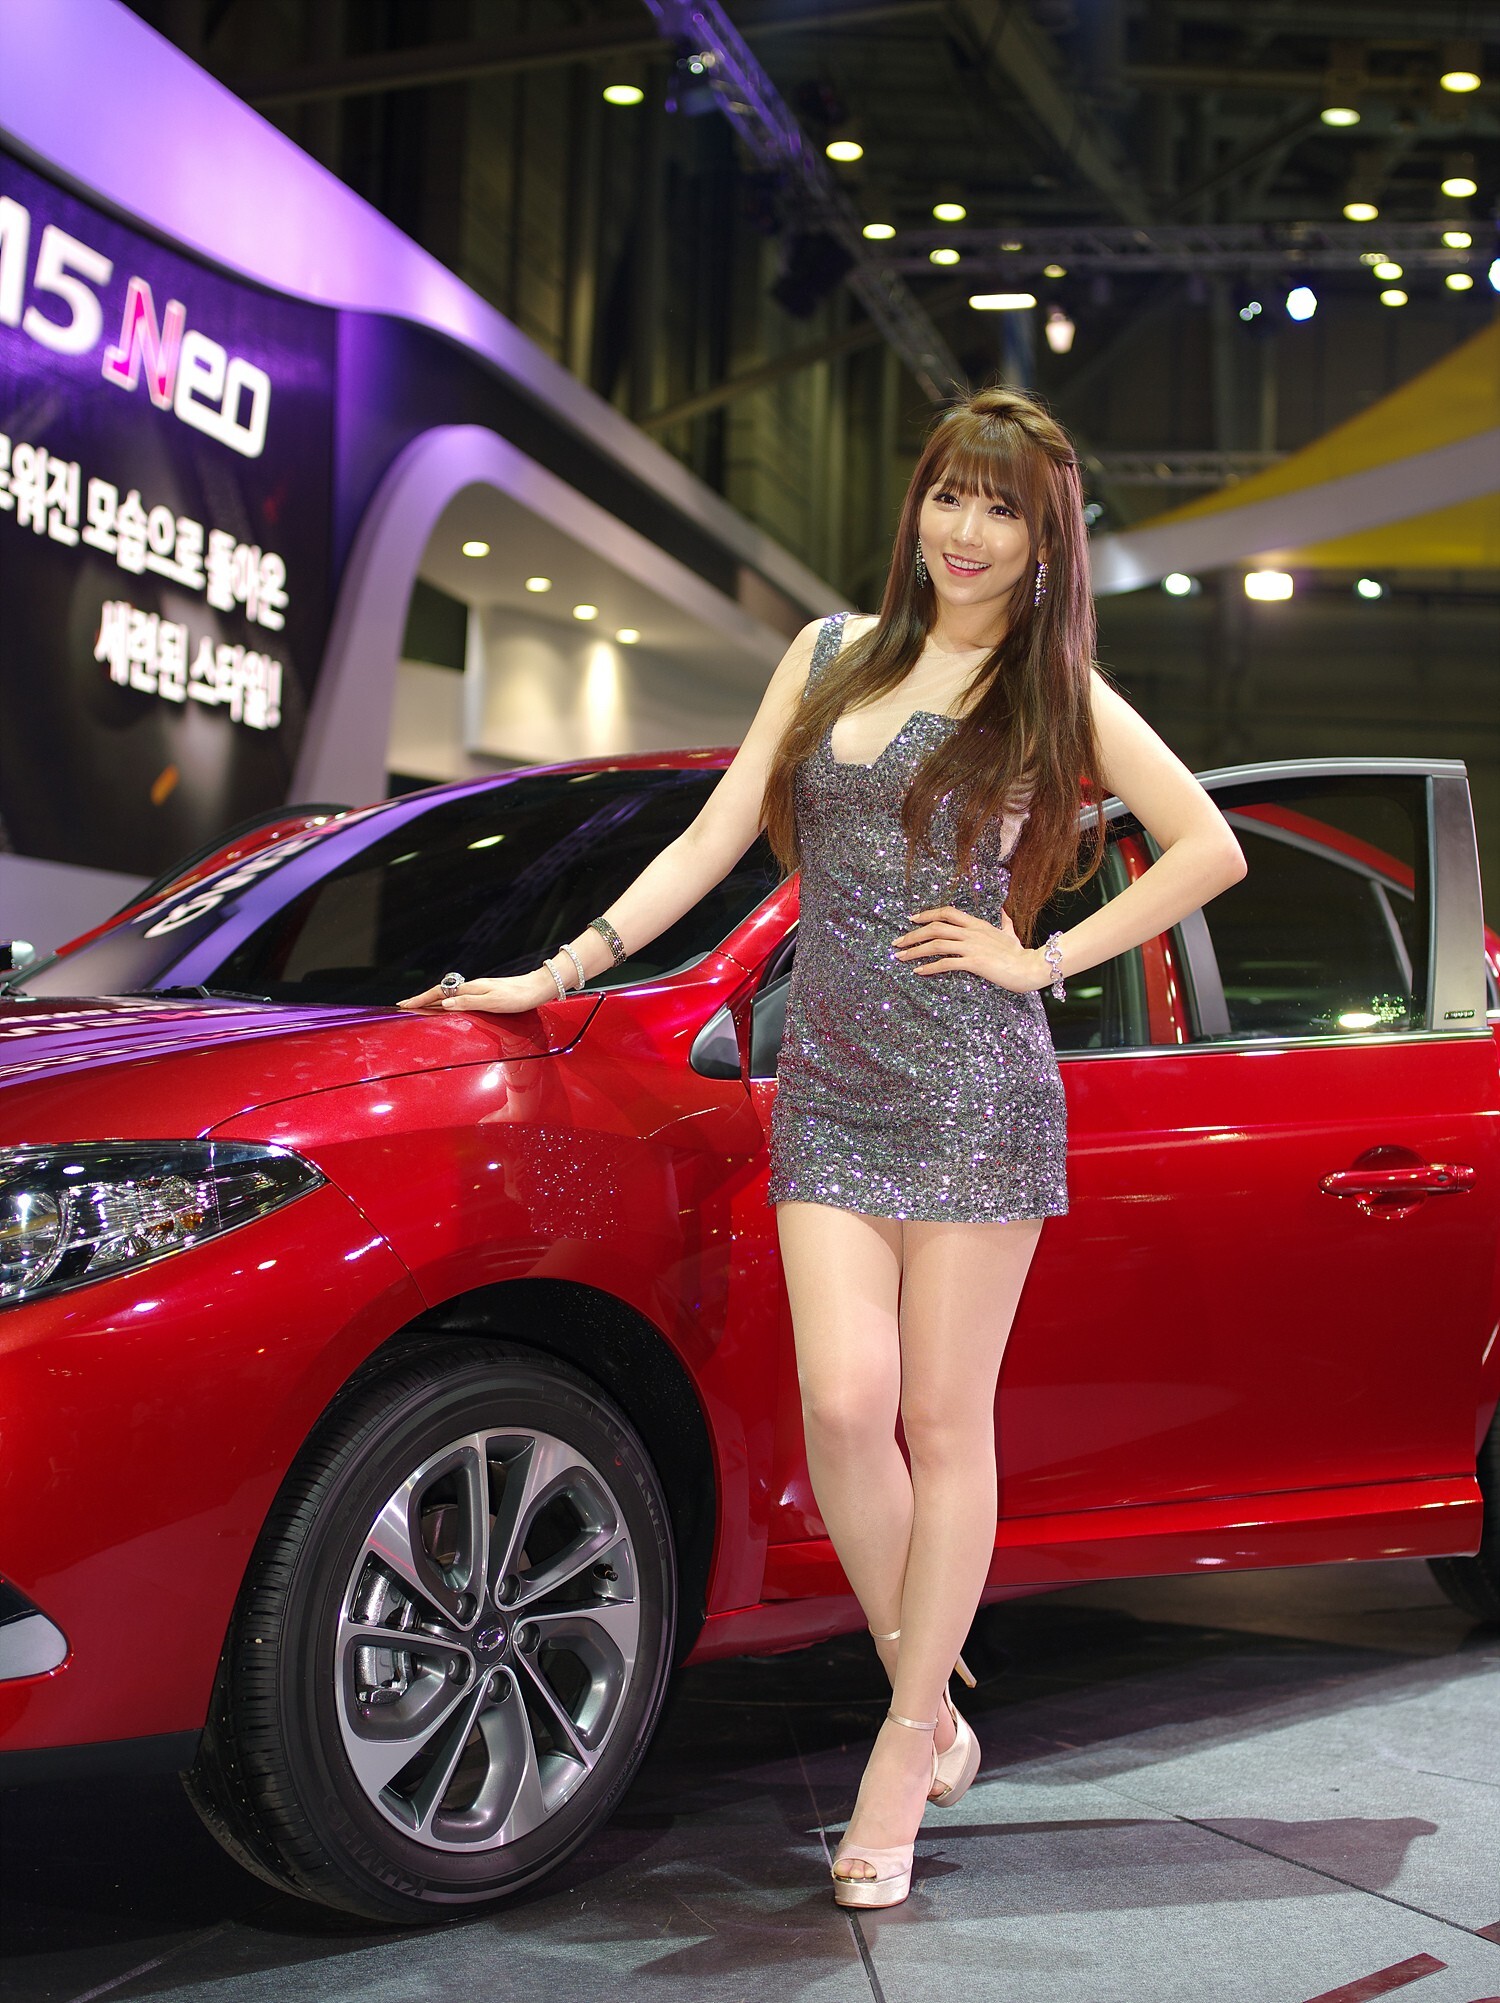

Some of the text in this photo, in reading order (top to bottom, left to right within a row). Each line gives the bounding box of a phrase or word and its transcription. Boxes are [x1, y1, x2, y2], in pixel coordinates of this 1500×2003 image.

[82, 477, 206, 590] 모습으로
[204, 528, 288, 631] 돌아온
[94, 600, 282, 730] 세련된 스타일!
[324, 1794, 425, 1897] KUMHO
